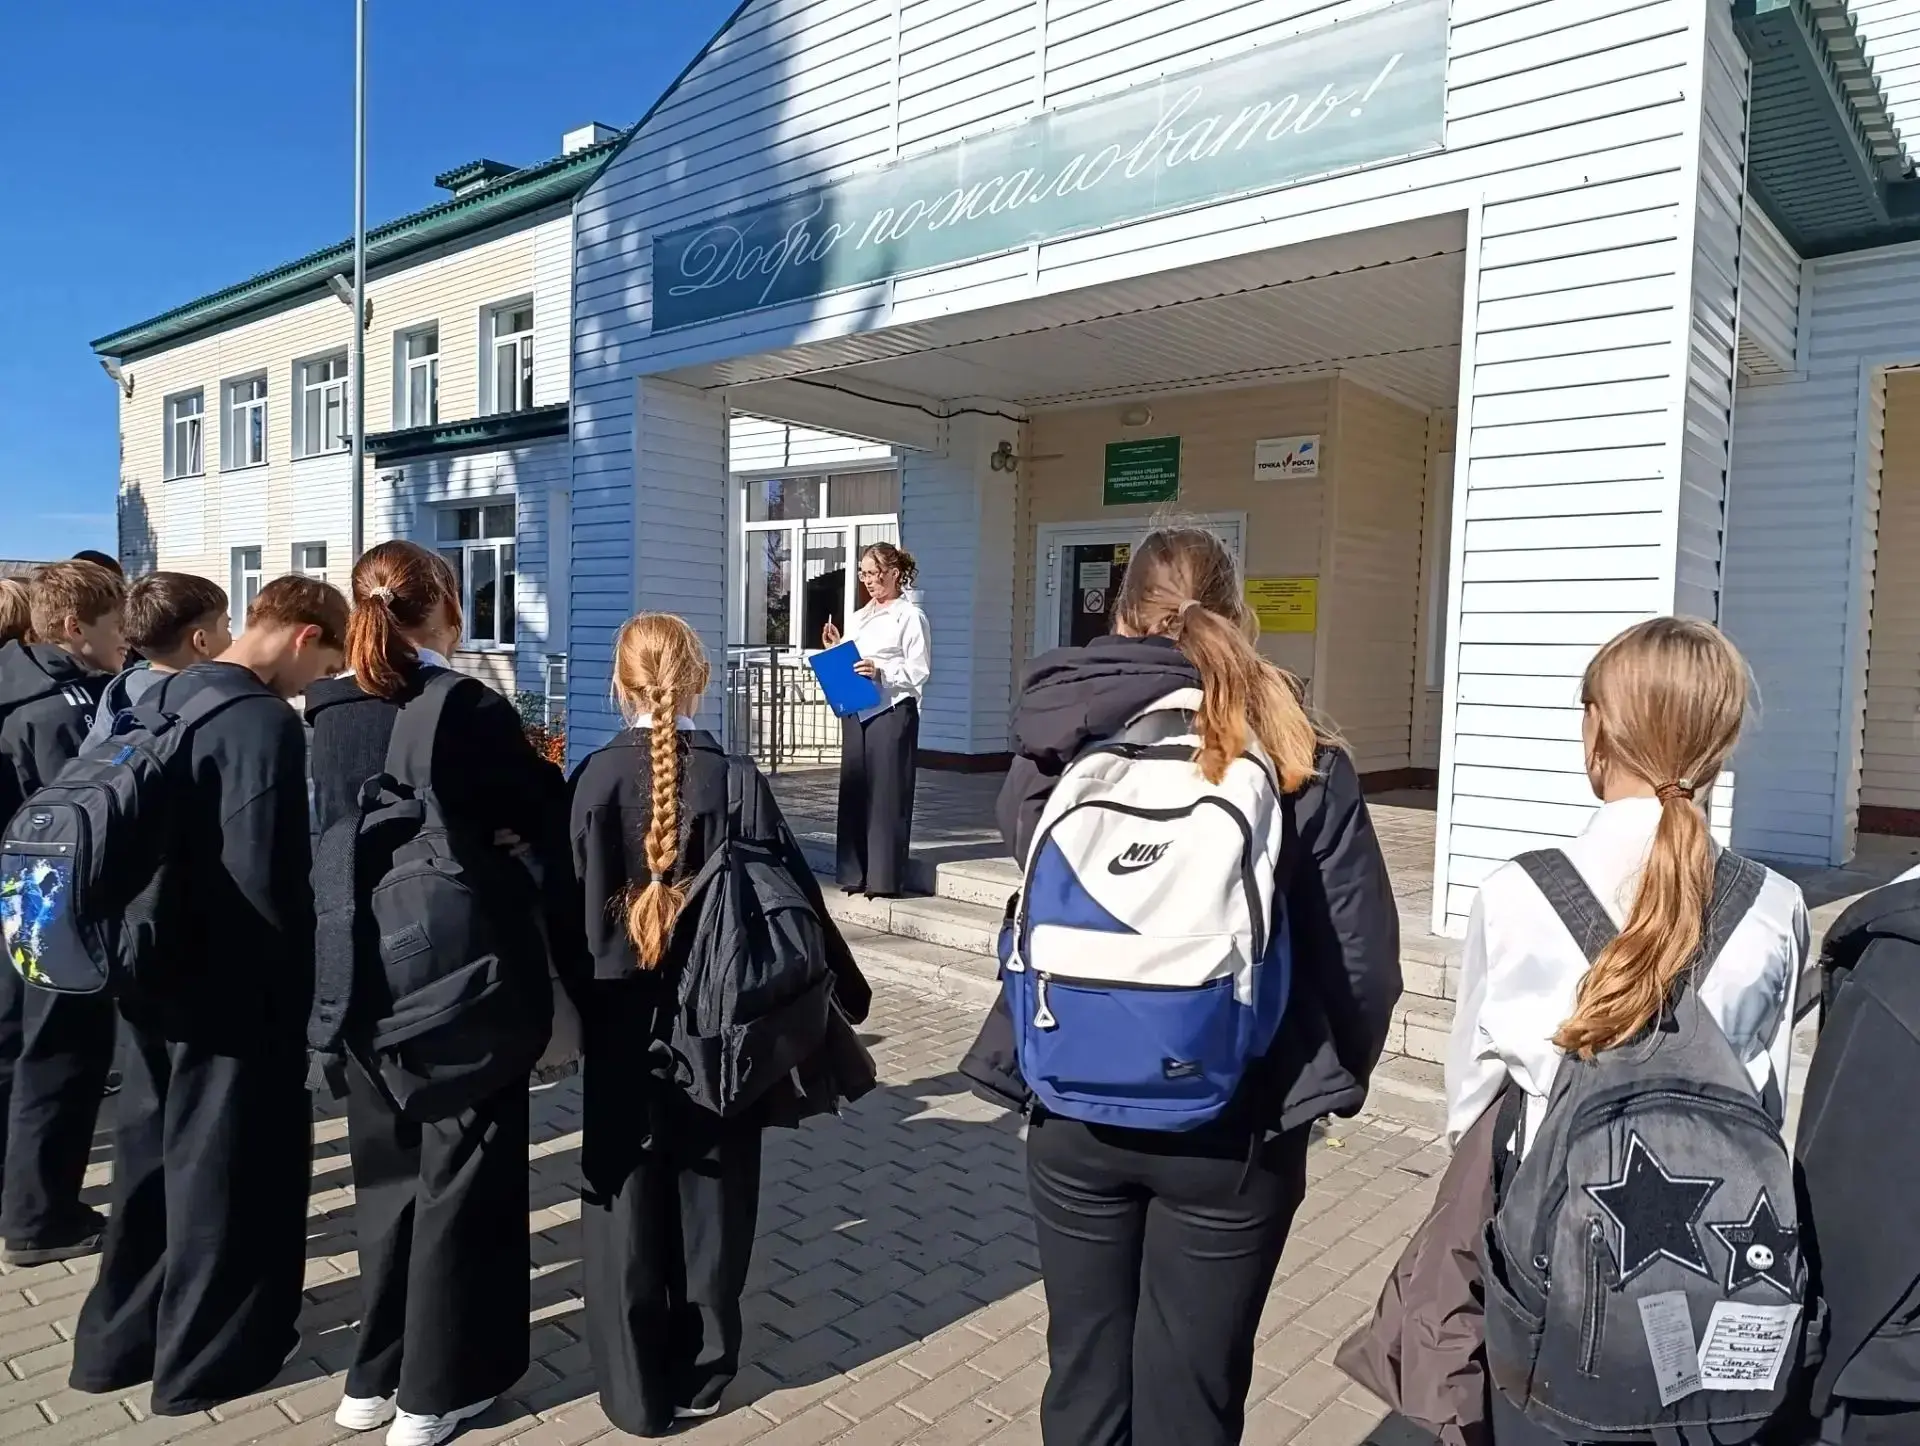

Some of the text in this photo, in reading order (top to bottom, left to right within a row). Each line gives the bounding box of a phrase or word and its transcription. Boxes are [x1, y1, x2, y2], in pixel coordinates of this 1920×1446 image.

[669, 53, 1404, 304] Добро пожаловать!
[1258, 459, 1315, 469] ТОЧКА РОСТА
